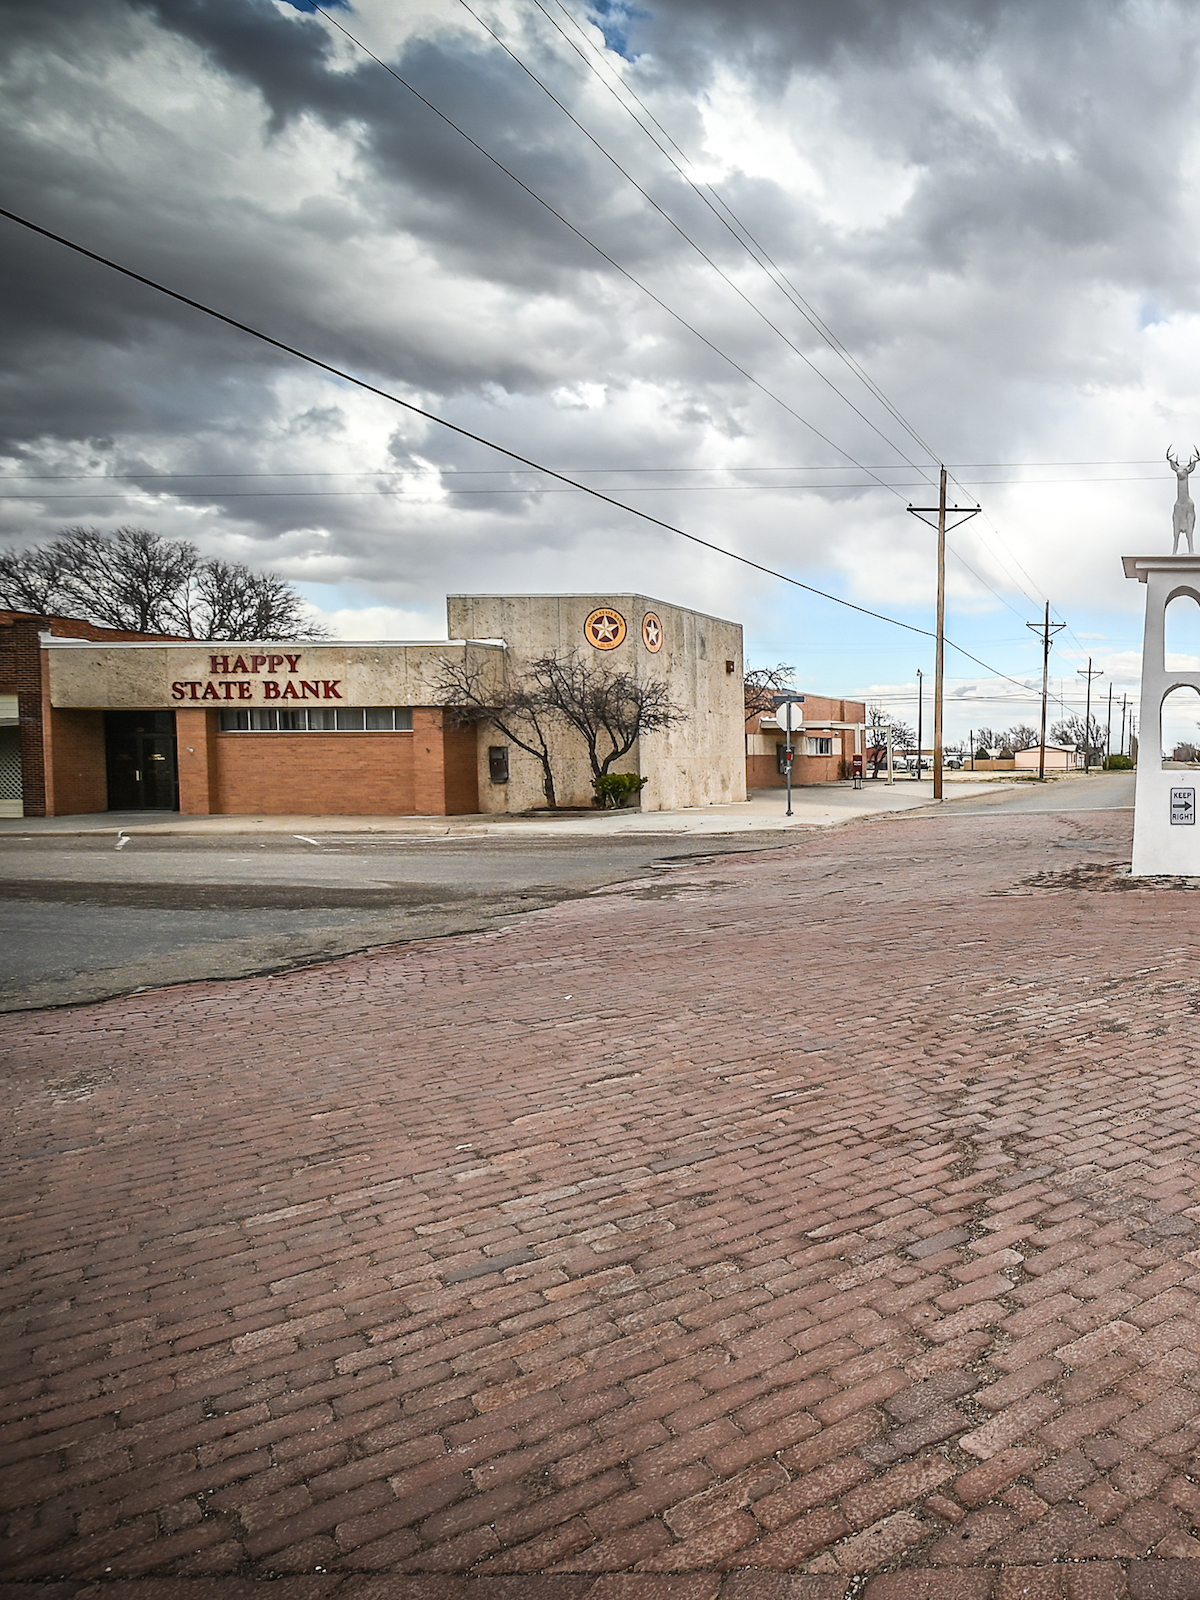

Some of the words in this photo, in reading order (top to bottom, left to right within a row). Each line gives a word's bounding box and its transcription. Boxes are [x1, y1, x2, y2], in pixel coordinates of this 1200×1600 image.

[209, 654, 301, 673] HAPPY
[171, 680, 253, 700] STATE
[262, 680, 343, 700] BANK
[1172, 813, 1193, 821] RIGHT
